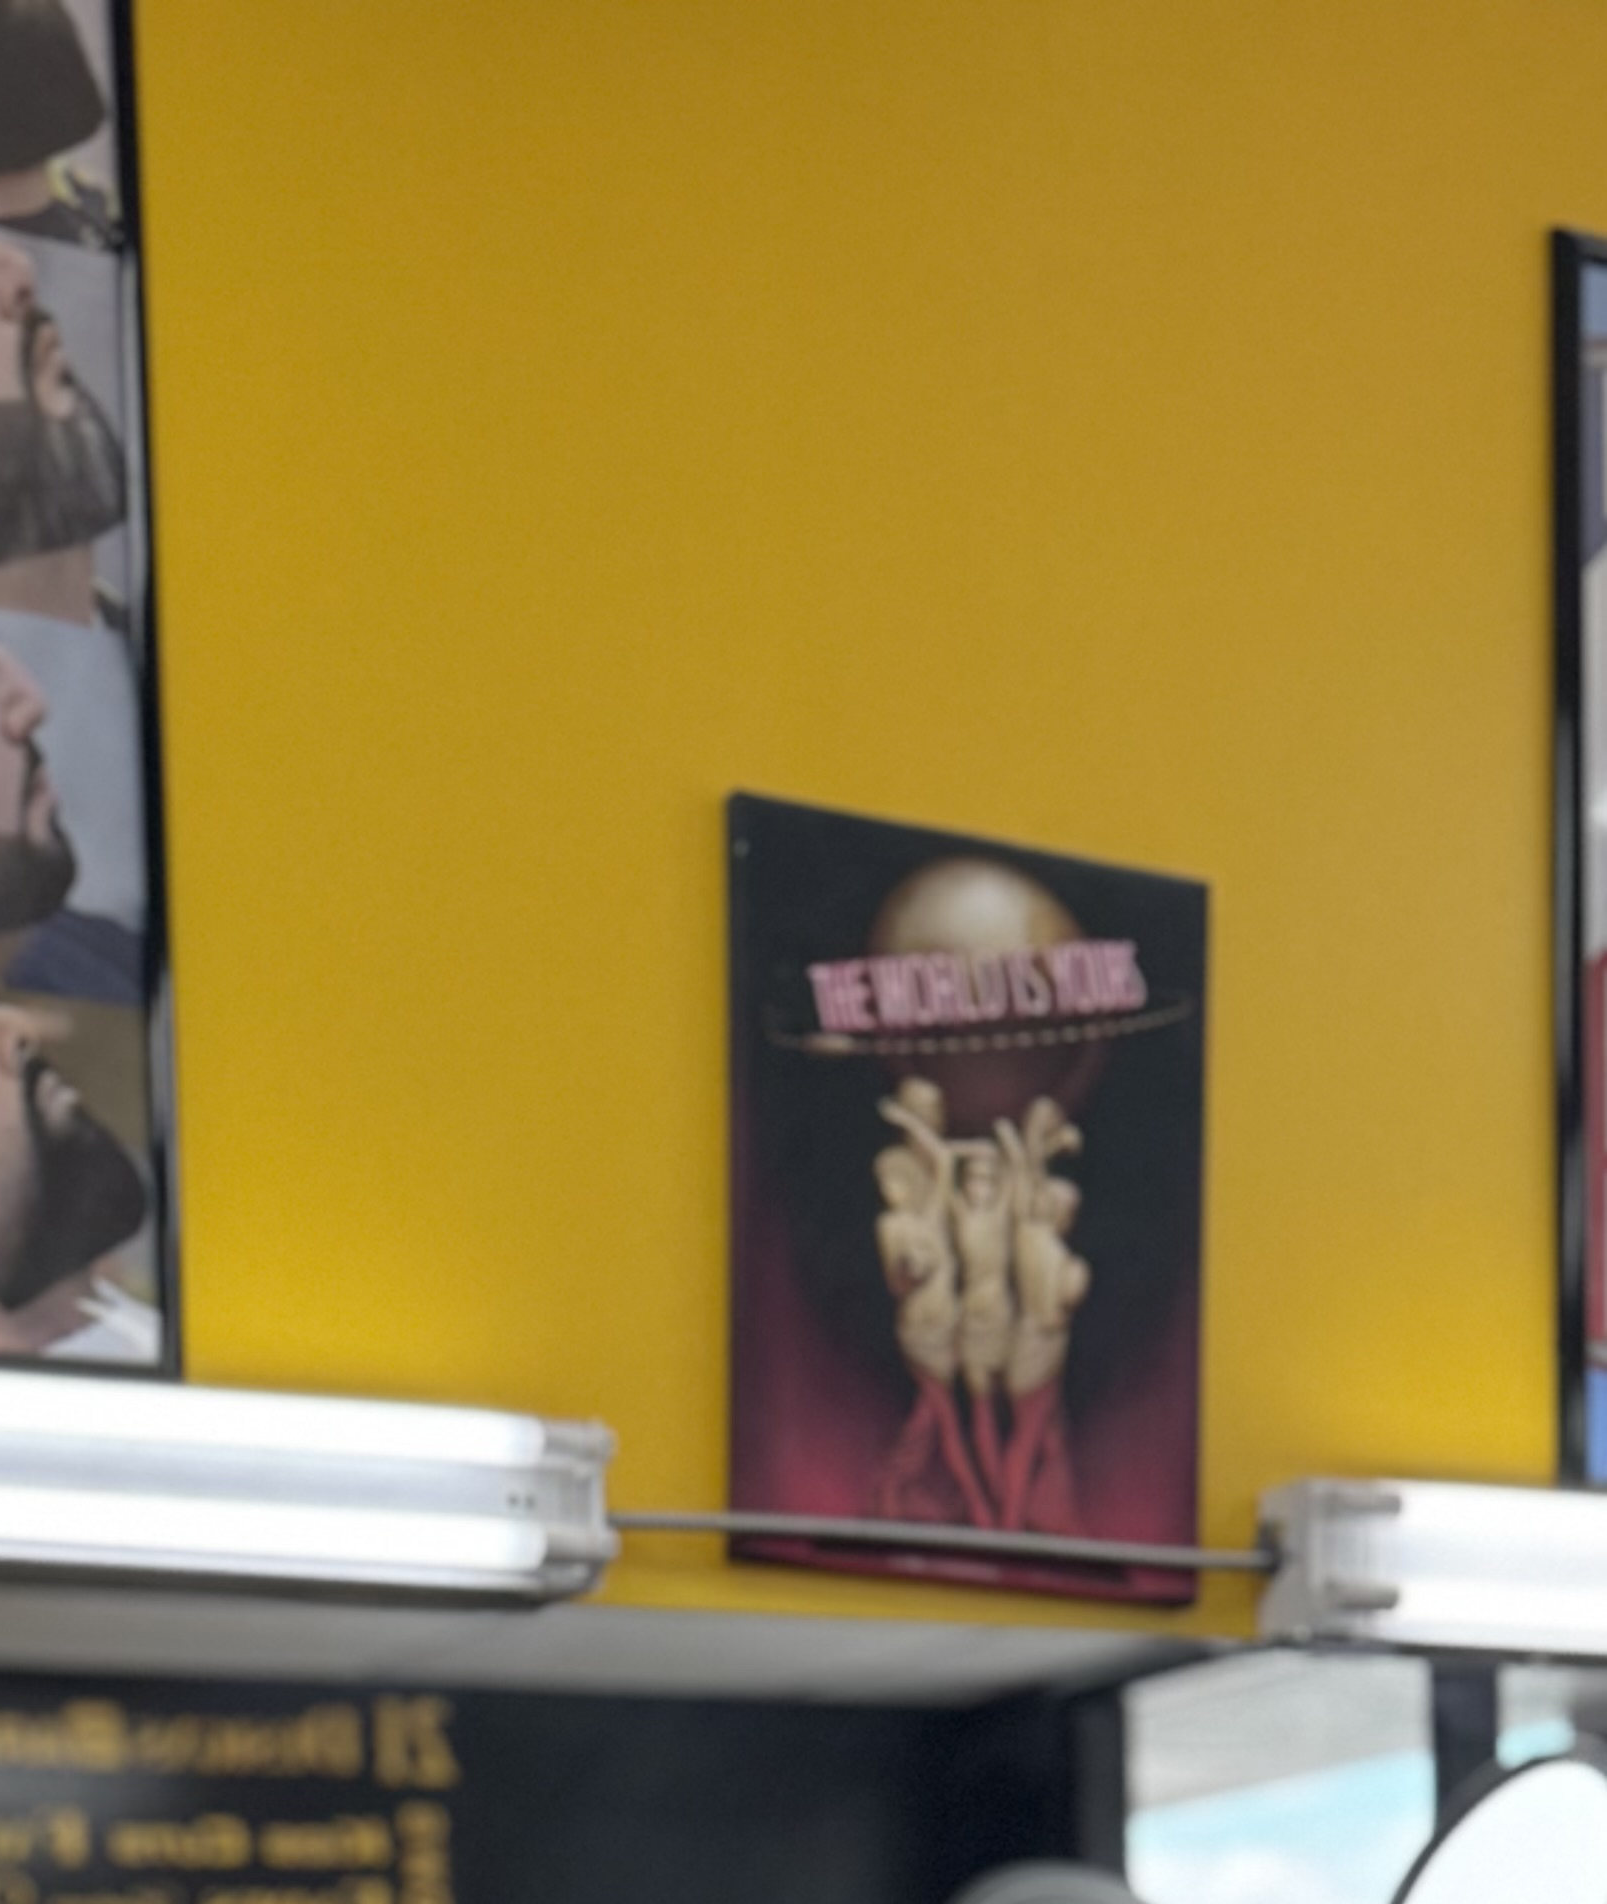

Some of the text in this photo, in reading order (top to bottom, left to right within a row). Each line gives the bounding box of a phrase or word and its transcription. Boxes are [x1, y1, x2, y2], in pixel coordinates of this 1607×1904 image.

[807, 939, 1148, 1031] THE WORLD IS YOURS
